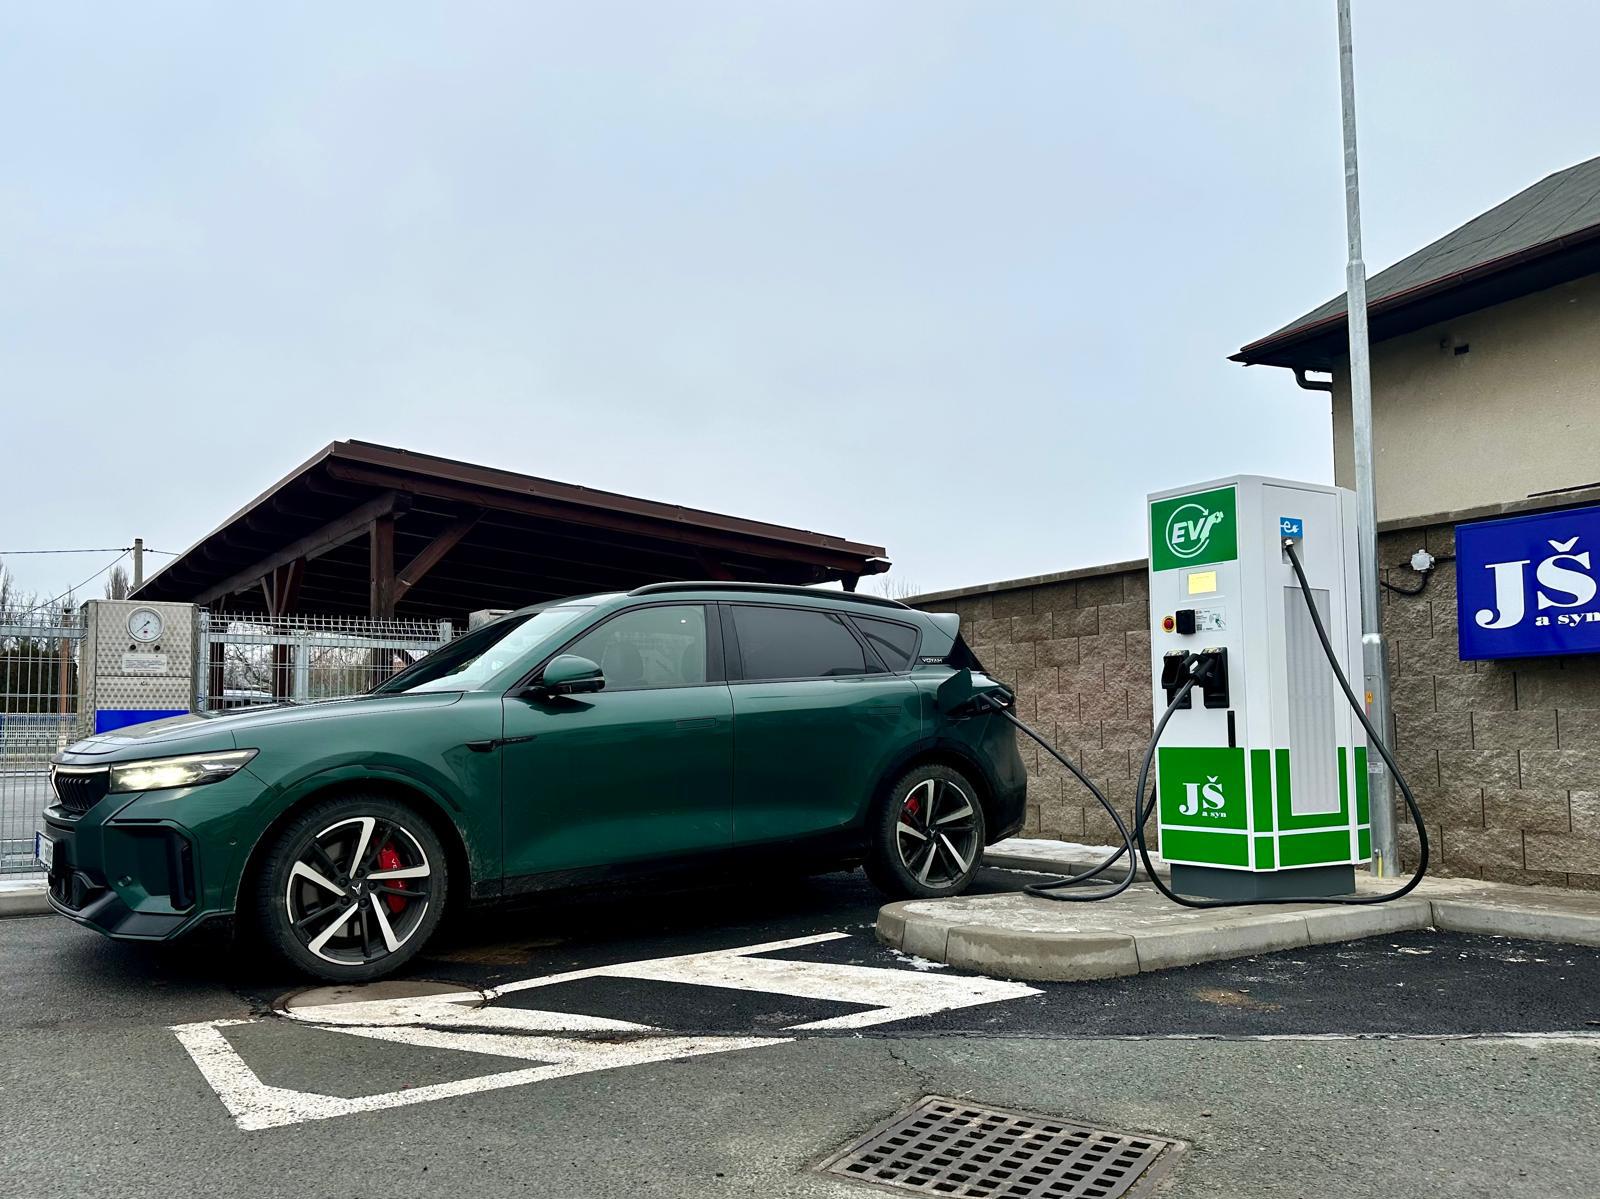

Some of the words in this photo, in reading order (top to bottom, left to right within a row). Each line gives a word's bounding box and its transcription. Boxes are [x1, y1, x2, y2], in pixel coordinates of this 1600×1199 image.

[1171, 517, 1205, 544] EV
[1475, 536, 1597, 629] JŠ
[1535, 616, 1550, 626] a
[1557, 611, 1600, 627] syn
[1179, 775, 1225, 816] JŠ
[1210, 811, 1227, 819] syn
